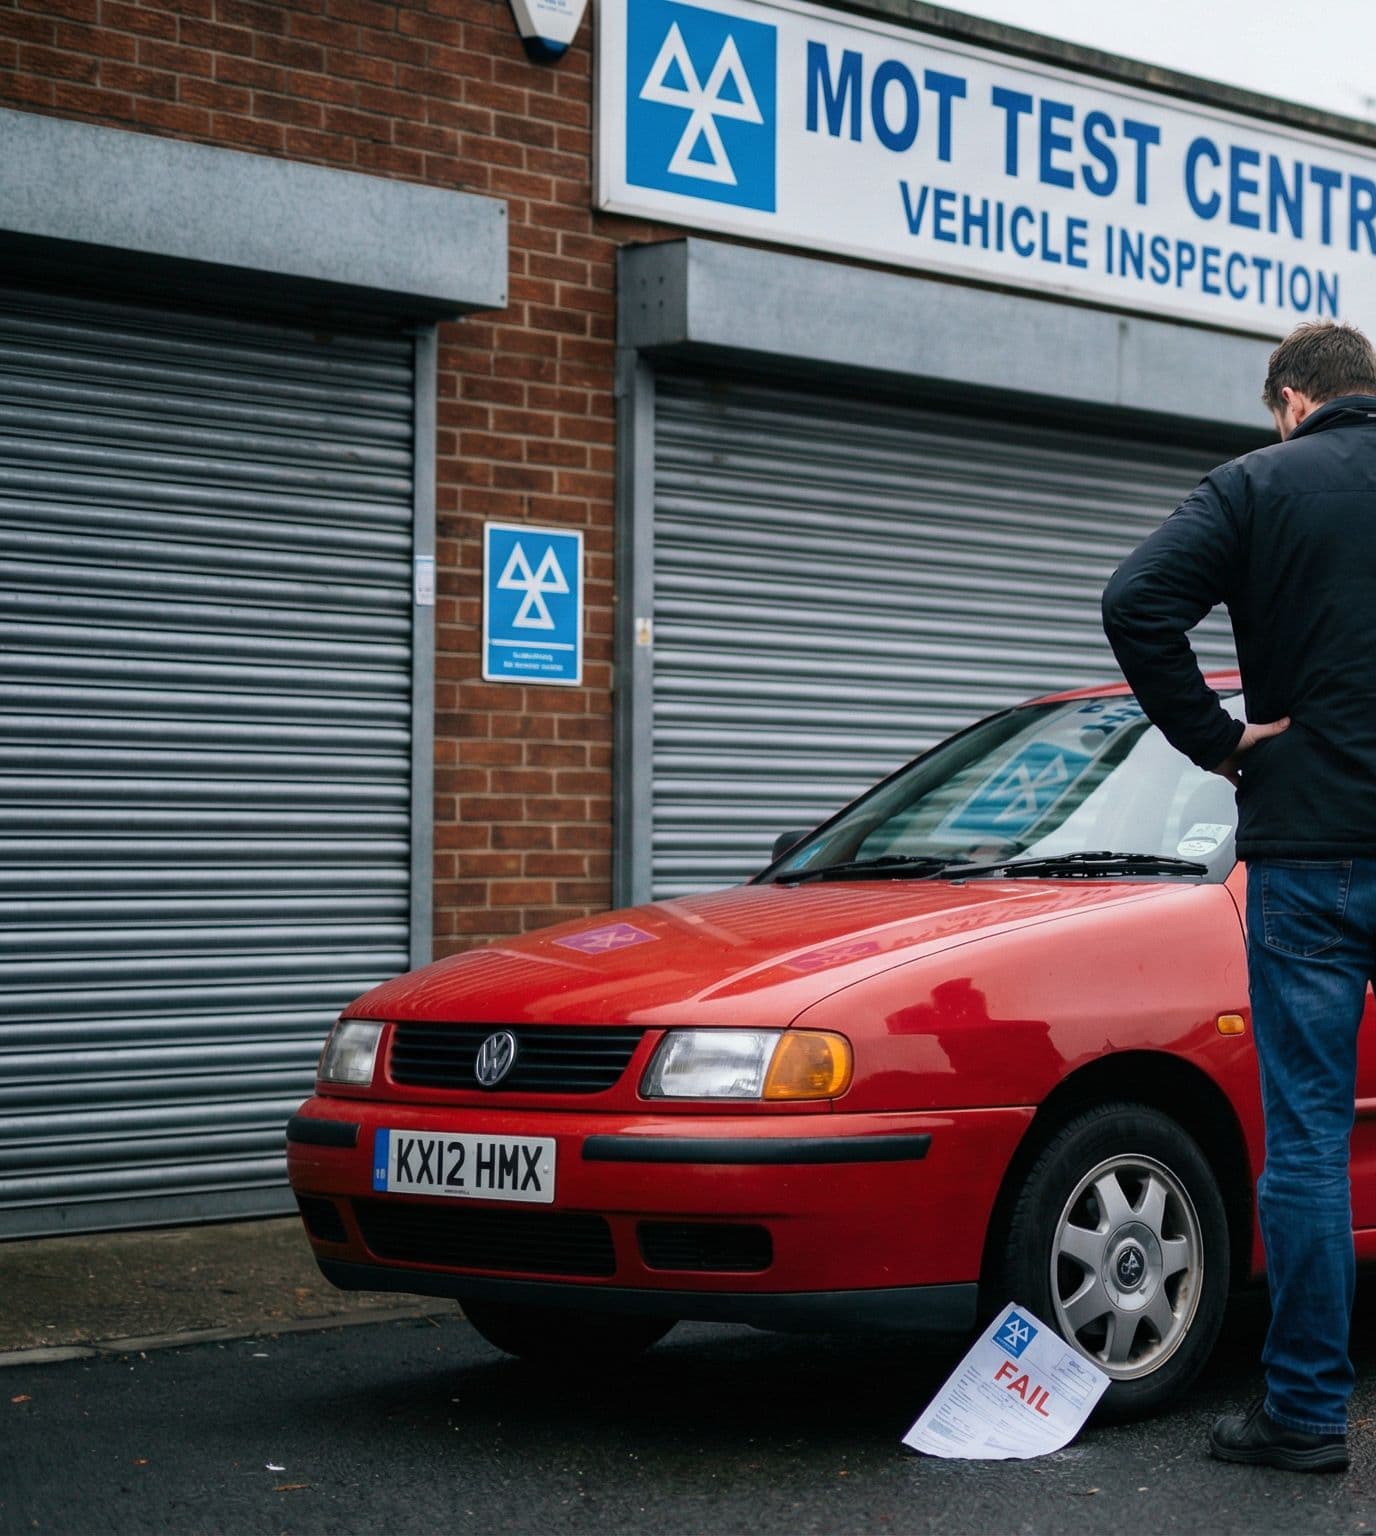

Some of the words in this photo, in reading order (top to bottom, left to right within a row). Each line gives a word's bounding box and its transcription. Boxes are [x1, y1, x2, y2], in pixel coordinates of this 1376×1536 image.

[806, 40, 967, 163] MOT
[991, 85, 1161, 206] TEST
[899, 180, 1089, 269] VEHICLE
[1106, 224, 1340, 318] INSPECTION
[396, 1138, 466, 1187] KX12
[475, 1142, 544, 1192] HMX
[994, 1360, 1050, 1418] FAIL
